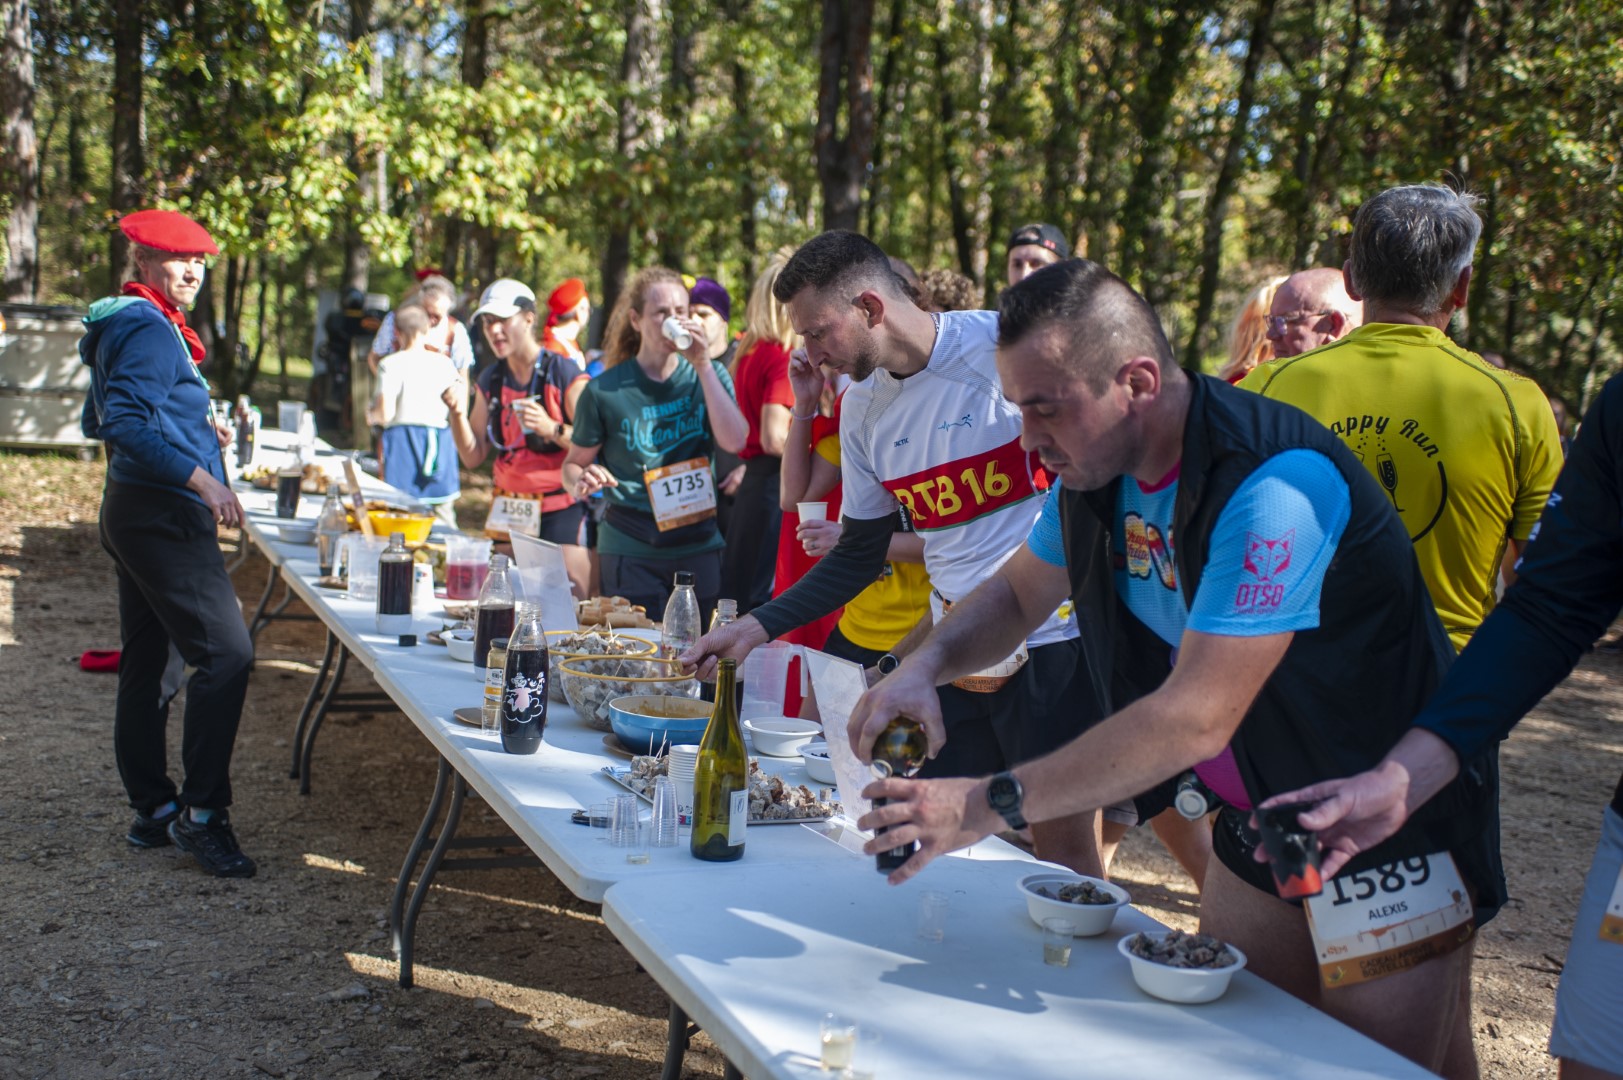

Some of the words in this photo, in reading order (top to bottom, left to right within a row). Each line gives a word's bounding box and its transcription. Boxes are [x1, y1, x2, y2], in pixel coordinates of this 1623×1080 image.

[621, 417, 674, 452] Urban
[664, 403, 706, 439] Trail
[1331, 415, 1390, 437] appy
[1399, 419, 1439, 458] Run
[662, 472, 705, 497] 1735
[893, 475, 962, 520] RTB
[960, 460, 1013, 506] 16
[501, 501, 532, 516] 1568
[1235, 583, 1284, 607] OTSO
[1332, 854, 1431, 906] 1589
[1368, 901, 1408, 920] ALEXIS
